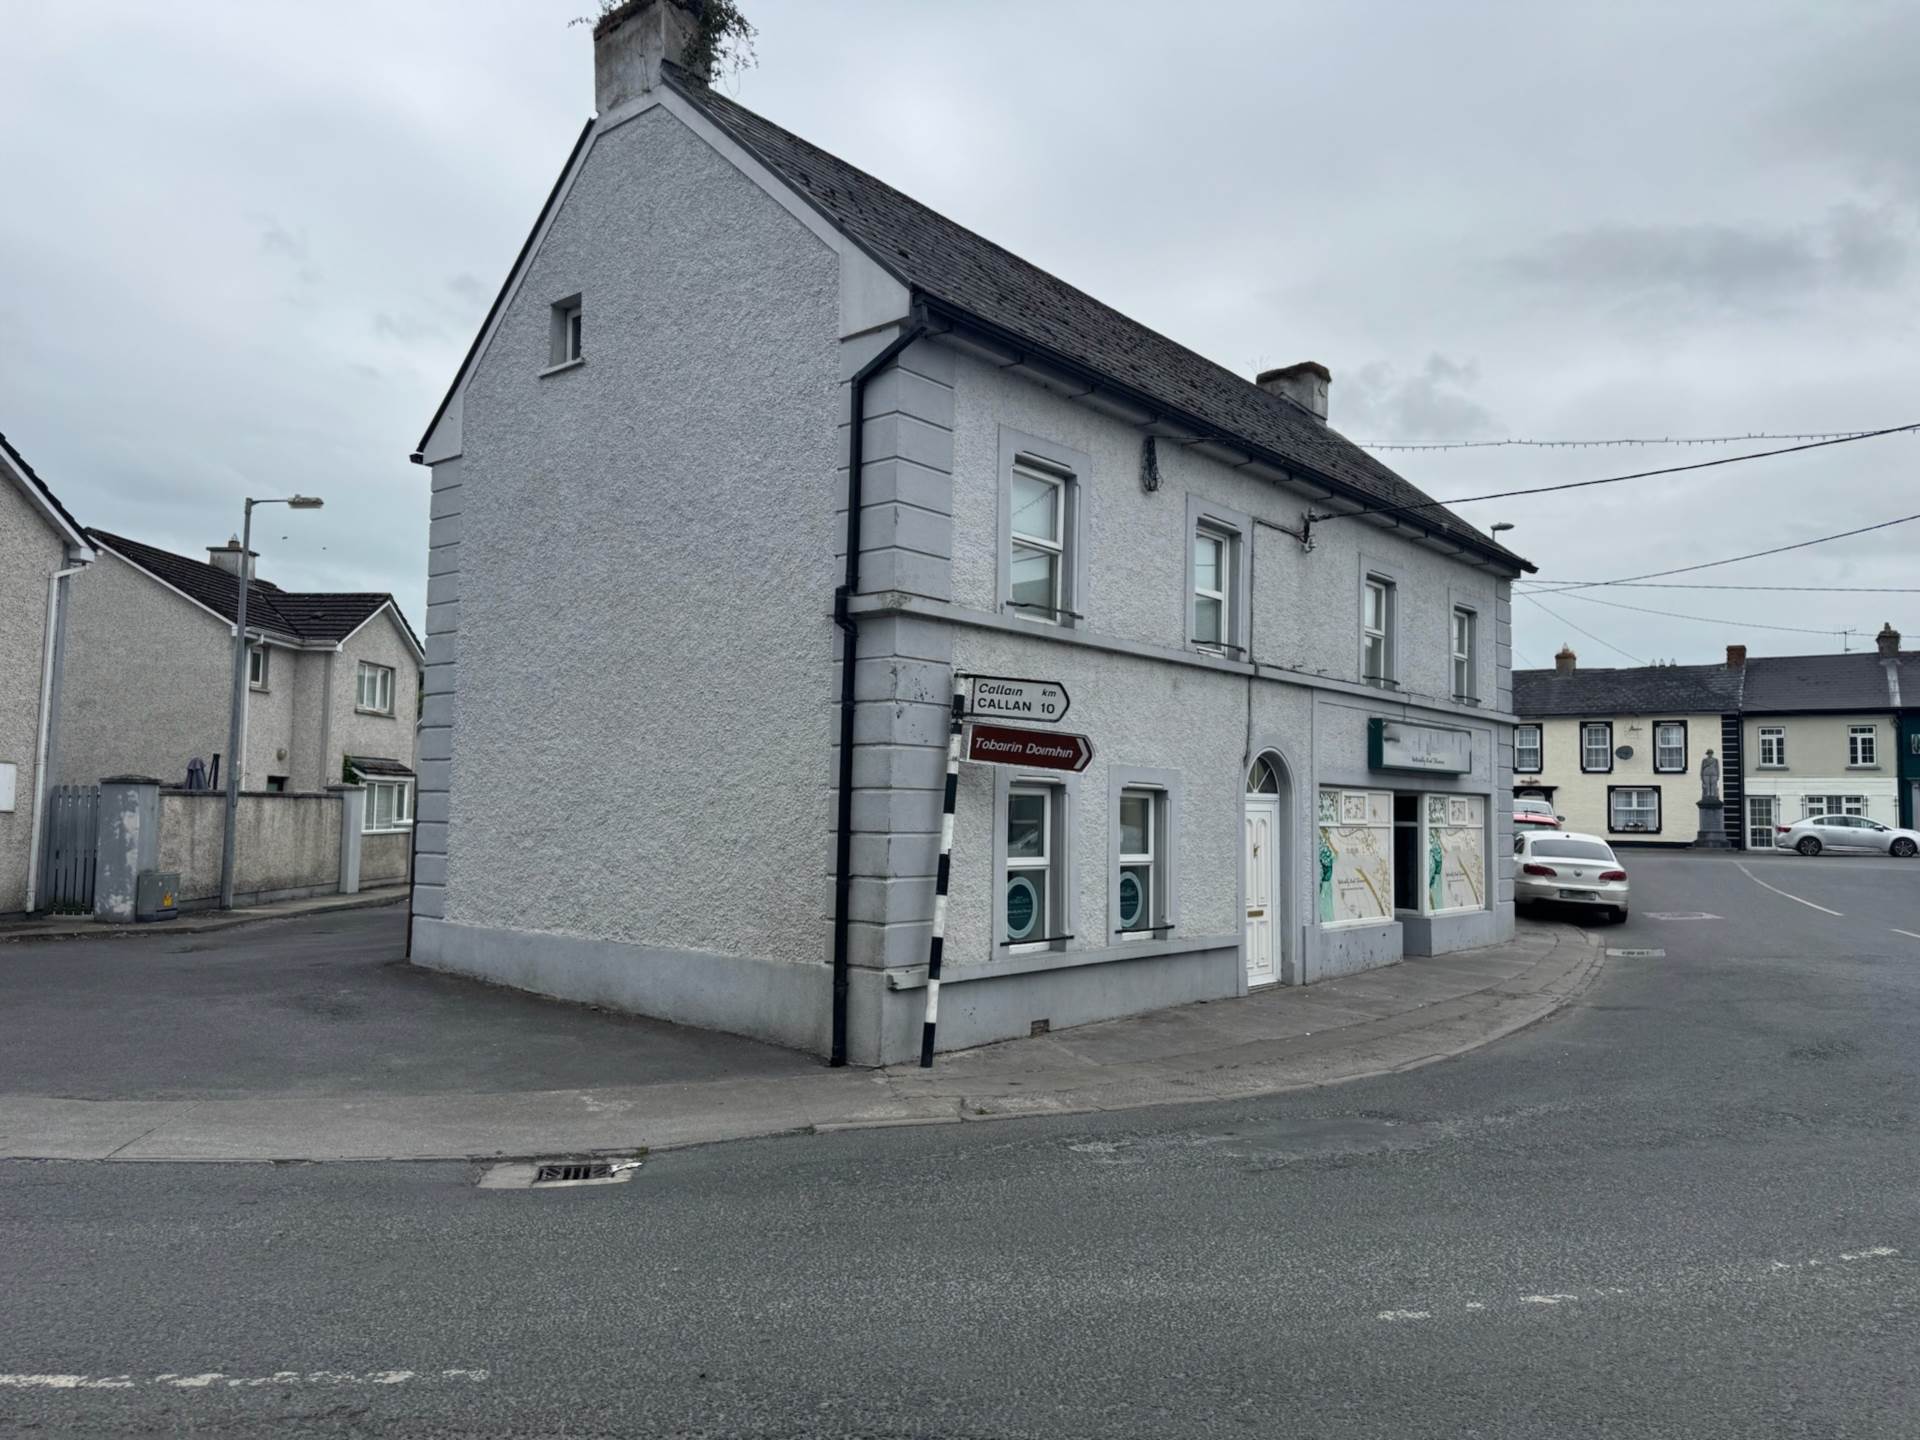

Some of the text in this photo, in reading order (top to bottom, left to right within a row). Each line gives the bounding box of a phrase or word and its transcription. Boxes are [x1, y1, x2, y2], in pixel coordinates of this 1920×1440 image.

[978, 683, 1057, 697] Callain km
[977, 697, 1056, 714] CALLAN 10
[1025, 743, 1074, 758] Doimhin
